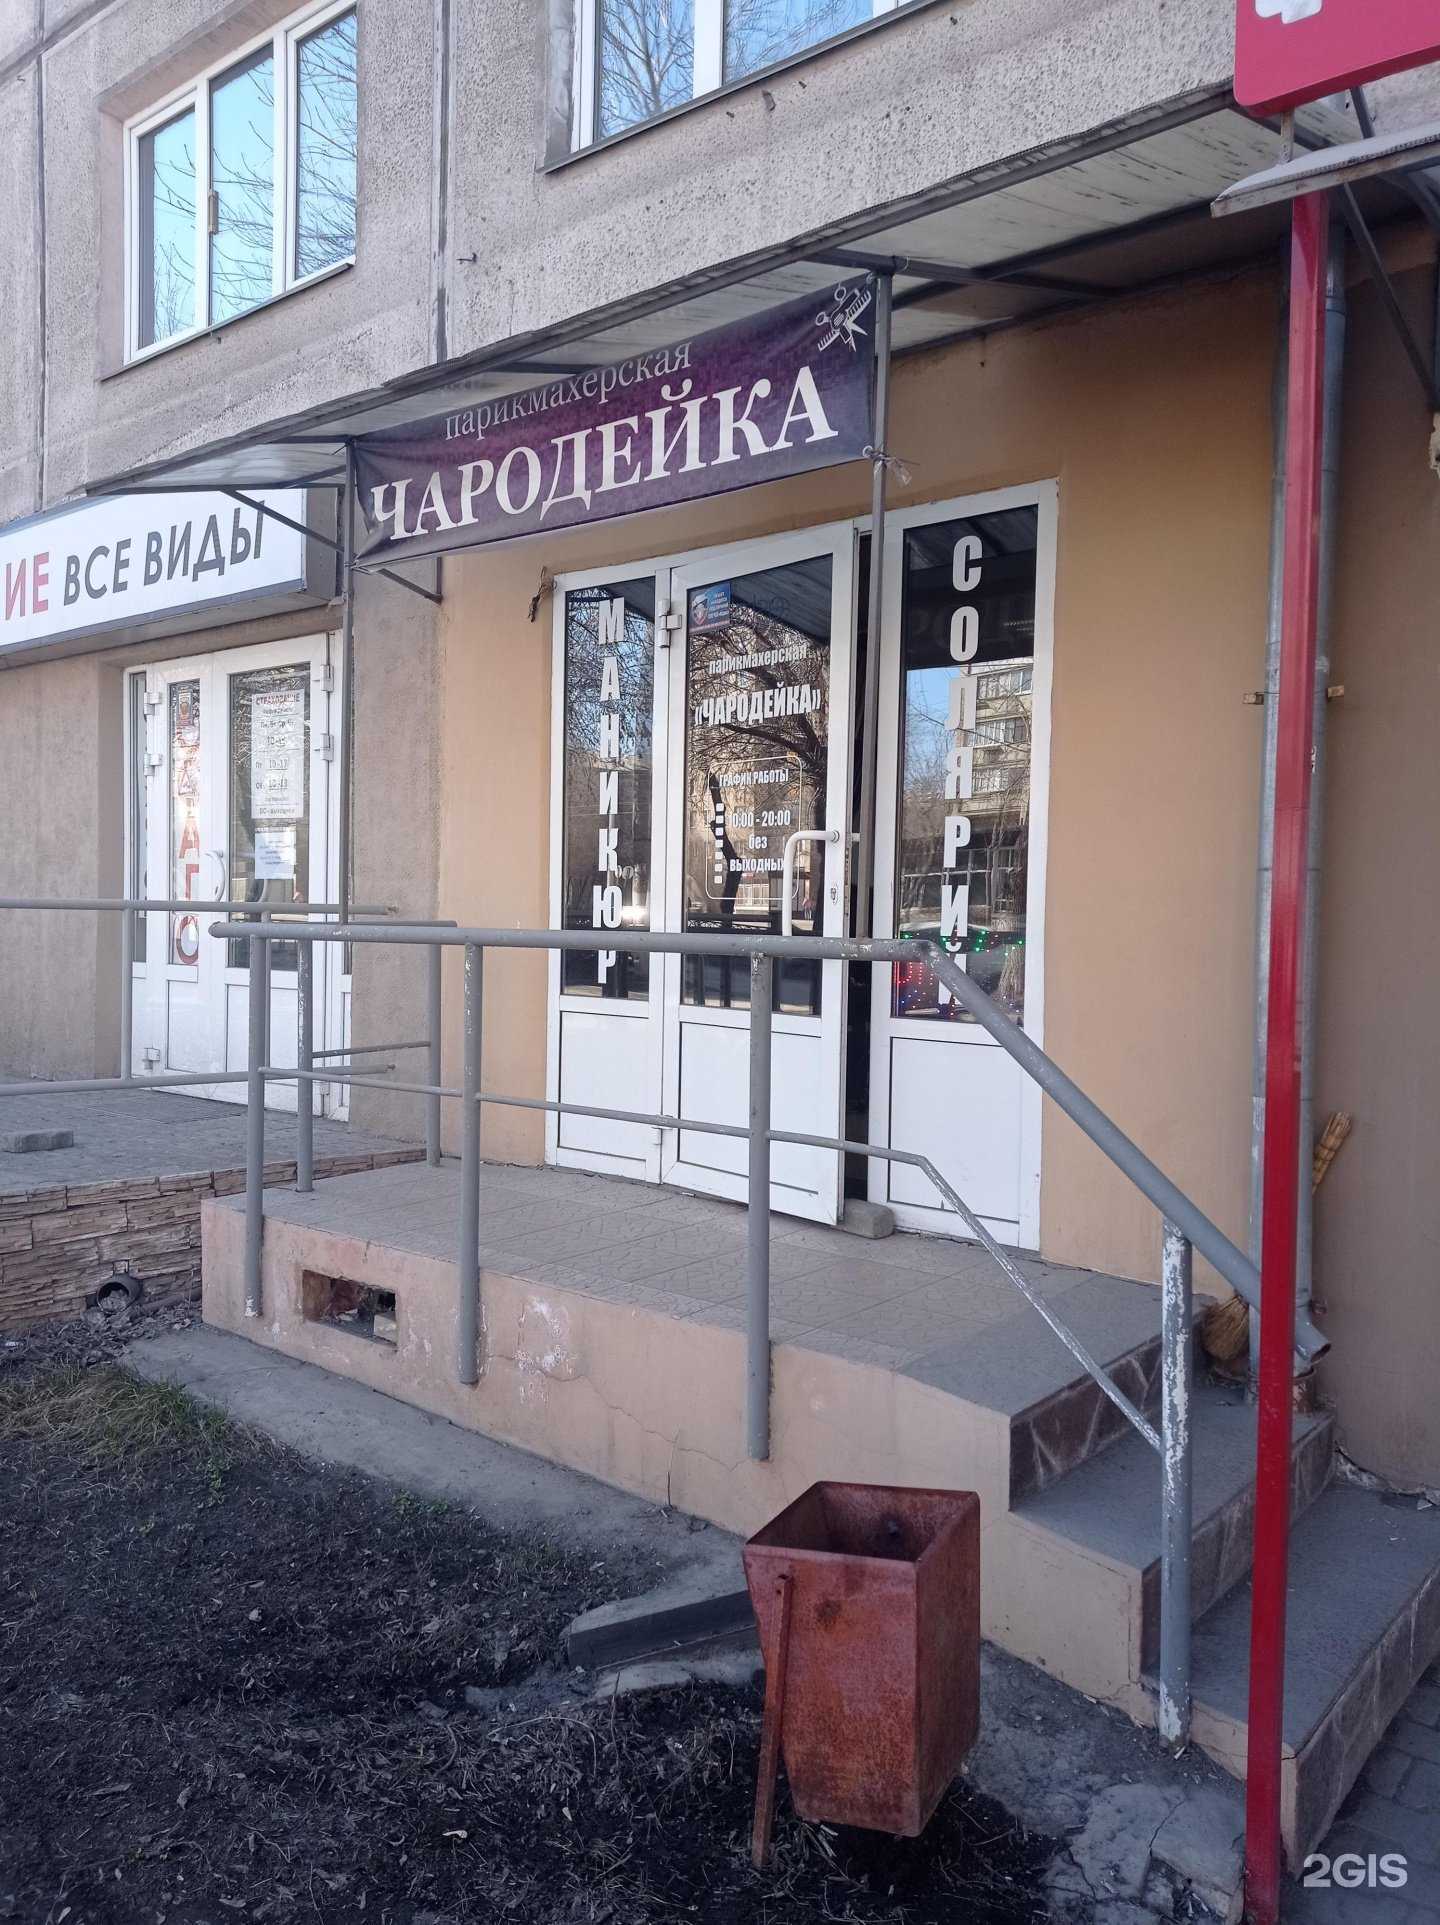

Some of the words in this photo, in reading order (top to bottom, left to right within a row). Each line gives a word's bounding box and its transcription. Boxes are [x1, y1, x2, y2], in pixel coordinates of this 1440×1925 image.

[445, 342, 692, 441] парикмахерская
[371, 365, 838, 541] ЧАРОДЕЙКА
[63, 538, 132, 606] ВСЕ
[143, 500, 265, 586] ВИДЫ
[709, 645, 807, 675] парикмахерская
[592, 597, 625, 984] МАНИКЮР
[753, 769, 789, 784] РАБОТЫ
[748, 834, 768, 849] без
[762, 809, 791, 827] 20:00
